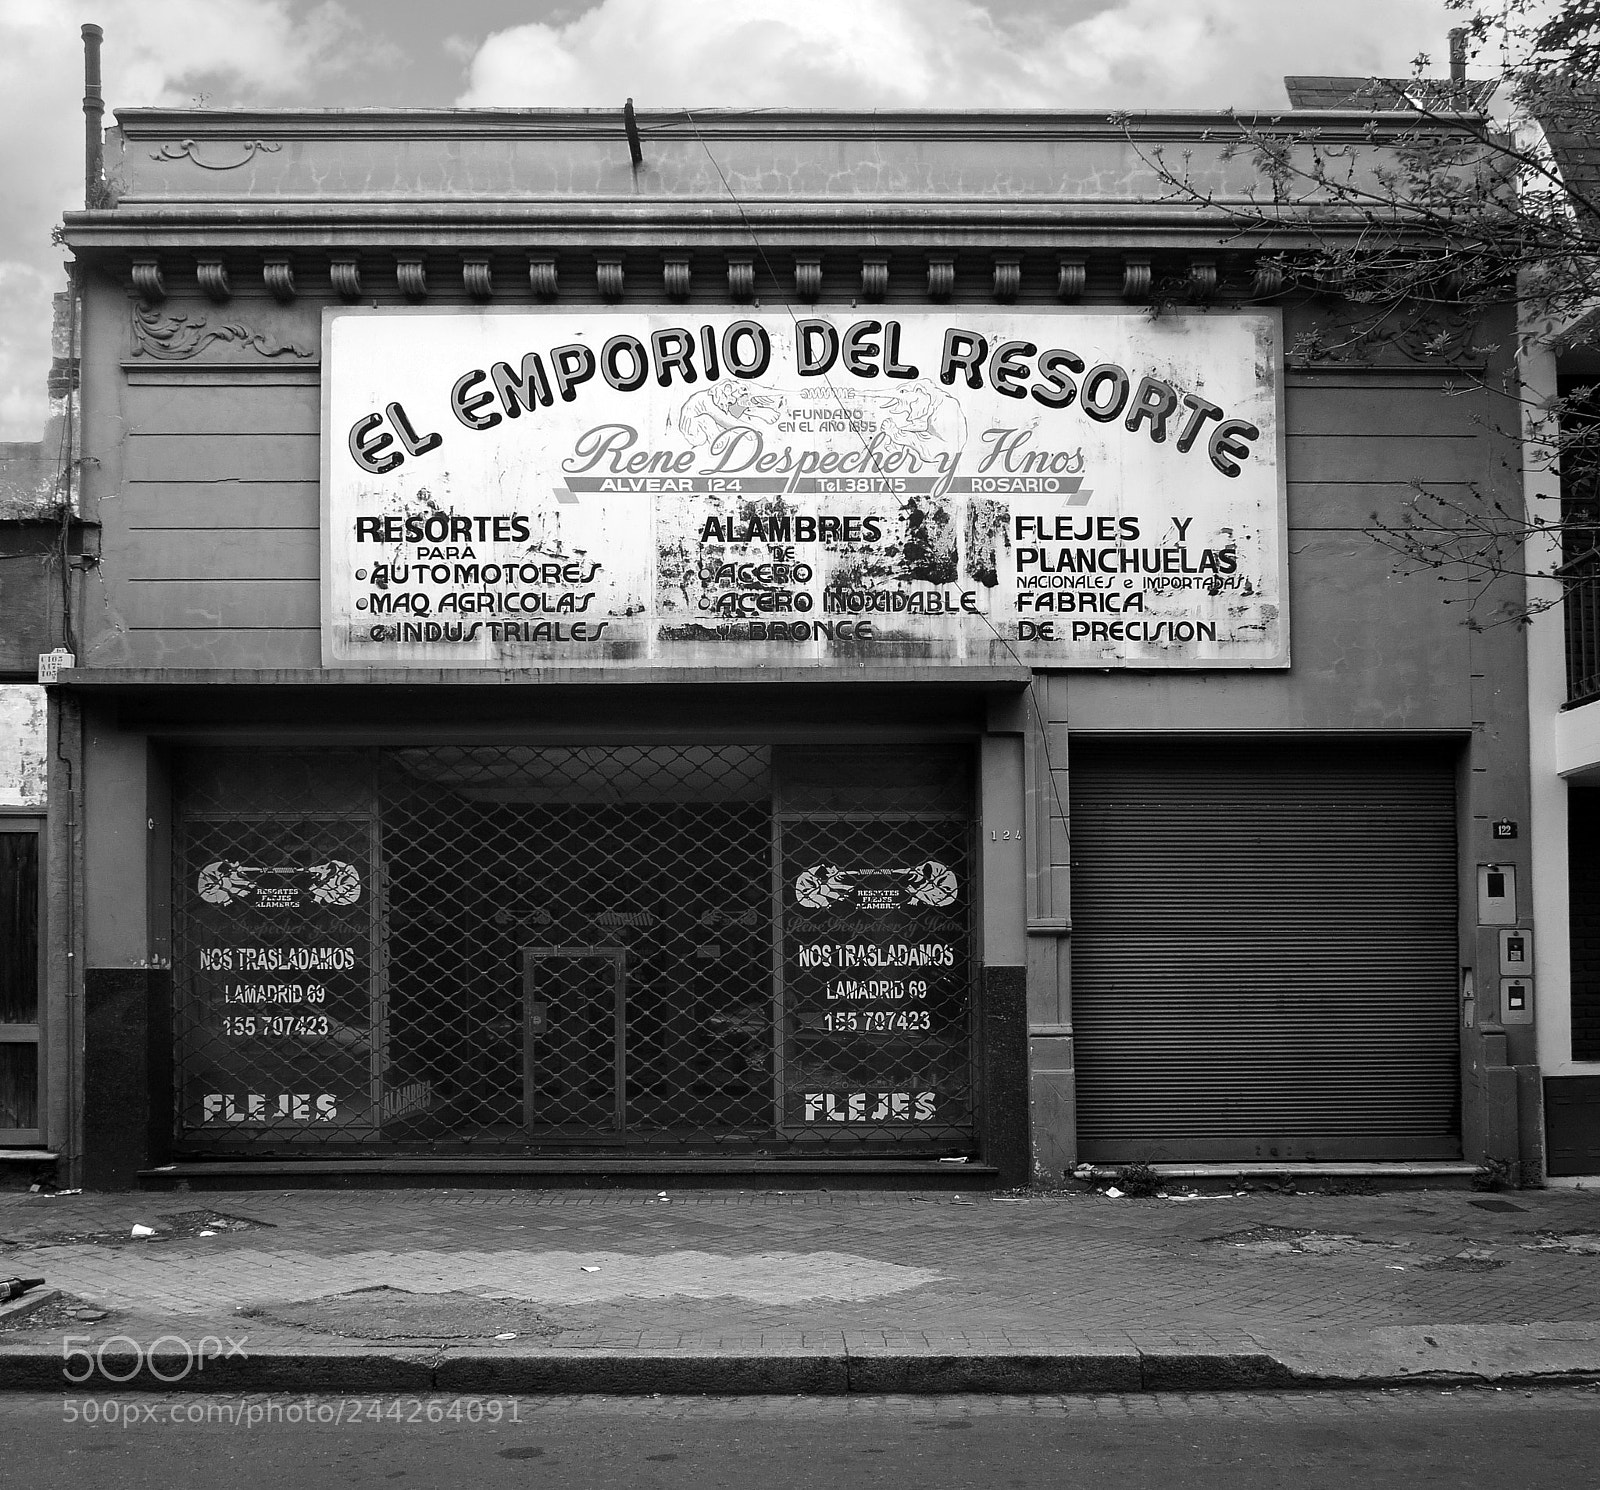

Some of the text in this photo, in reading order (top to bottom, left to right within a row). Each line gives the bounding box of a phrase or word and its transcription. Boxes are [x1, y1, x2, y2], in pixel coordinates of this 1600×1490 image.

[348, 317, 1260, 478] EL EMPORIO DEL RESORTE
[792, 408, 864, 420] FUNDADO
[778, 421, 796, 432] EN
[799, 421, 814, 432] EL
[819, 420, 846, 432] AÑO
[561, 423, 696, 474] Rene
[699, 425, 922, 493] Despecher
[930, 451, 962, 498] y
[600, 479, 694, 492] ALVEAR
[707, 479, 742, 492] 124
[971, 478, 1060, 492] ROSARIO
[356, 516, 530, 542] RESORTES
[700, 516, 883, 543] ALAMBRES
[1015, 516, 1193, 541] FLEJES Y
[417, 546, 477, 560] PARA
[772, 546, 795, 559] DE
[1016, 548, 1237, 573] PLANCHUELAS
[370, 563, 602, 584] AUTOMOTORES
[714, 563, 813, 584] ACERO
[1016, 575, 1245, 589] NACIONALES e IMPORTADAS
[438, 592, 597, 613] AGRICOLAS
[716, 591, 978, 613] ACERO INOXIDABLE
[1016, 592, 1144, 613] FABRICA
[396, 621, 609, 643] INDUSTRIALES
[749, 621, 873, 641] BRONCE
[1018, 621, 1217, 642] DE PRECISION
[991, 830, 1022, 841] 124
[1498, 825, 1511, 836] 122
[200, 948, 355, 971] NOS TRASLADAMOS
[799, 944, 954, 967] NOS TRASLADAMOS
[225, 984, 325, 1004] LAMADRID 69
[826, 980, 927, 1000] LAMADRID 69
[223, 1016, 329, 1036] 155 707423
[824, 1011, 931, 1031] 155 707423
[203, 1094, 337, 1122] FLEJES
[805, 1092, 936, 1121] FLEJES
